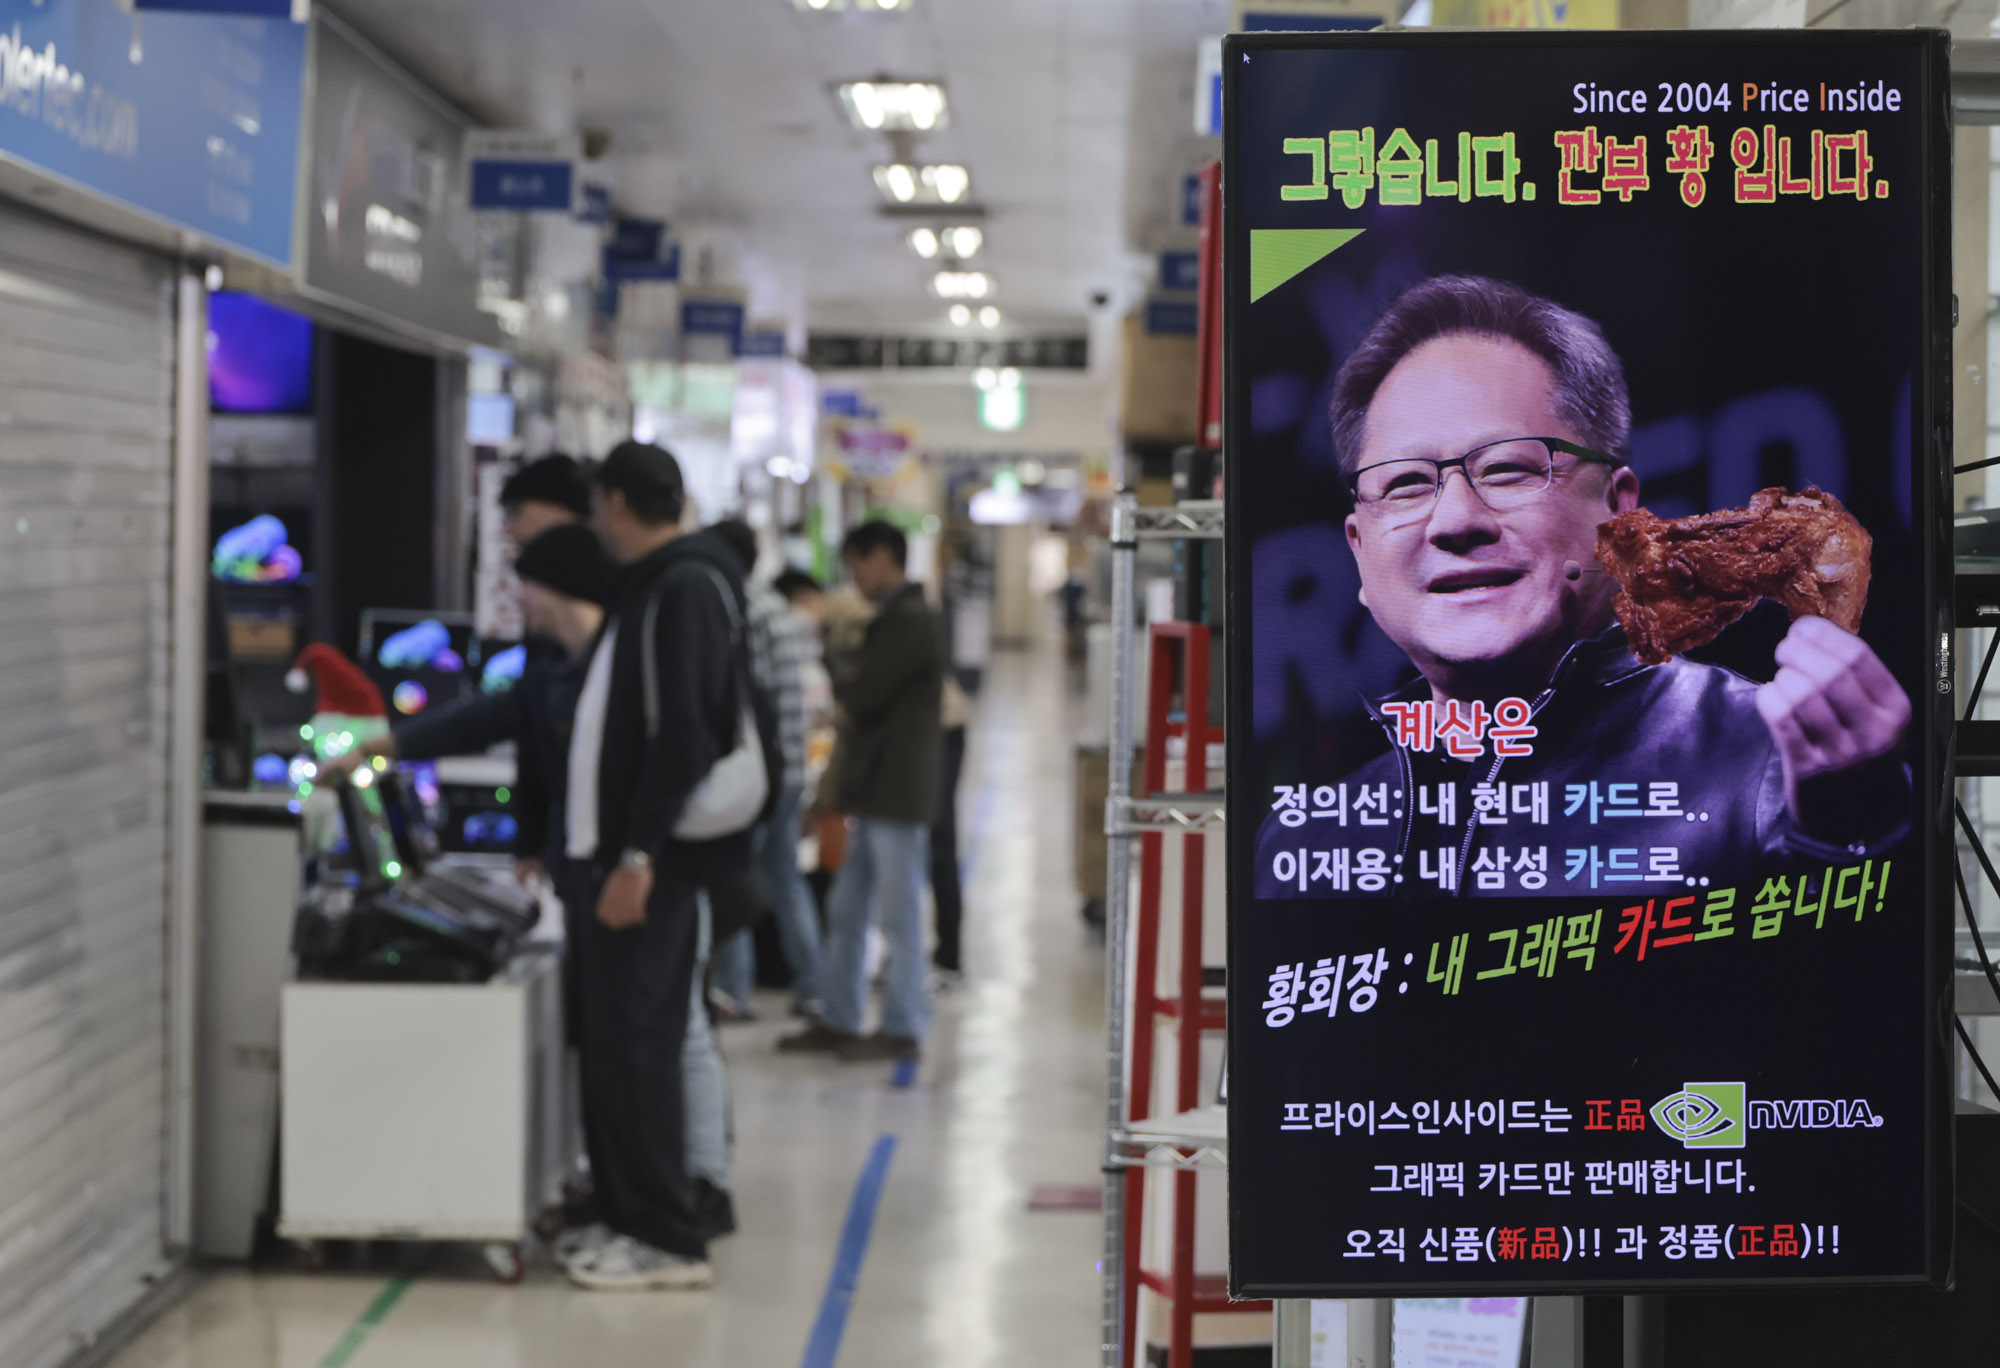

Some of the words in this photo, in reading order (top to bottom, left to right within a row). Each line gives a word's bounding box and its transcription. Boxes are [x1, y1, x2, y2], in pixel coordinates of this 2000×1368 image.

[1573, 82, 1648, 113] Since
[1658, 82, 1732, 113] 2004
[1743, 81, 1810, 112] Price
[1820, 79, 1902, 112] Inside
[1281, 126, 1536, 209] 그렇습니다.
[1553, 126, 1650, 205] 깐부
[1665, 124, 1715, 208] 황
[1731, 124, 1889, 204] 입니다.
[1380, 697, 1538, 757] 계산은
[1271, 783, 1403, 827] 정의선:
[1418, 782, 1457, 826] 내
[1471, 781, 1549, 825] 현대
[1564, 780, 1709, 825] 카드로..
[1272, 848, 1404, 892] 이재용:
[1418, 847, 1457, 891] 내
[1471, 845, 1548, 890] 삼성
[1564, 845, 1710, 889] 카드로..
[1426, 932, 1470, 996] 내
[1476, 908, 1603, 981] 그래픽
[1613, 888, 1736, 962] 카드로
[1750, 859, 1891, 940] 쏩니다!
[1280, 1099, 1573, 1136] 프라이스인사이드는
[1584, 1099, 1645, 1131] 正品
[1370, 1162, 1465, 1197] 그래픽
[1478, 1160, 1575, 1196] 카드만
[1584, 1158, 1756, 1195] 판매합니다.
[1342, 1227, 1405, 1263] 오직
[1615, 1225, 1648, 1260] 과
